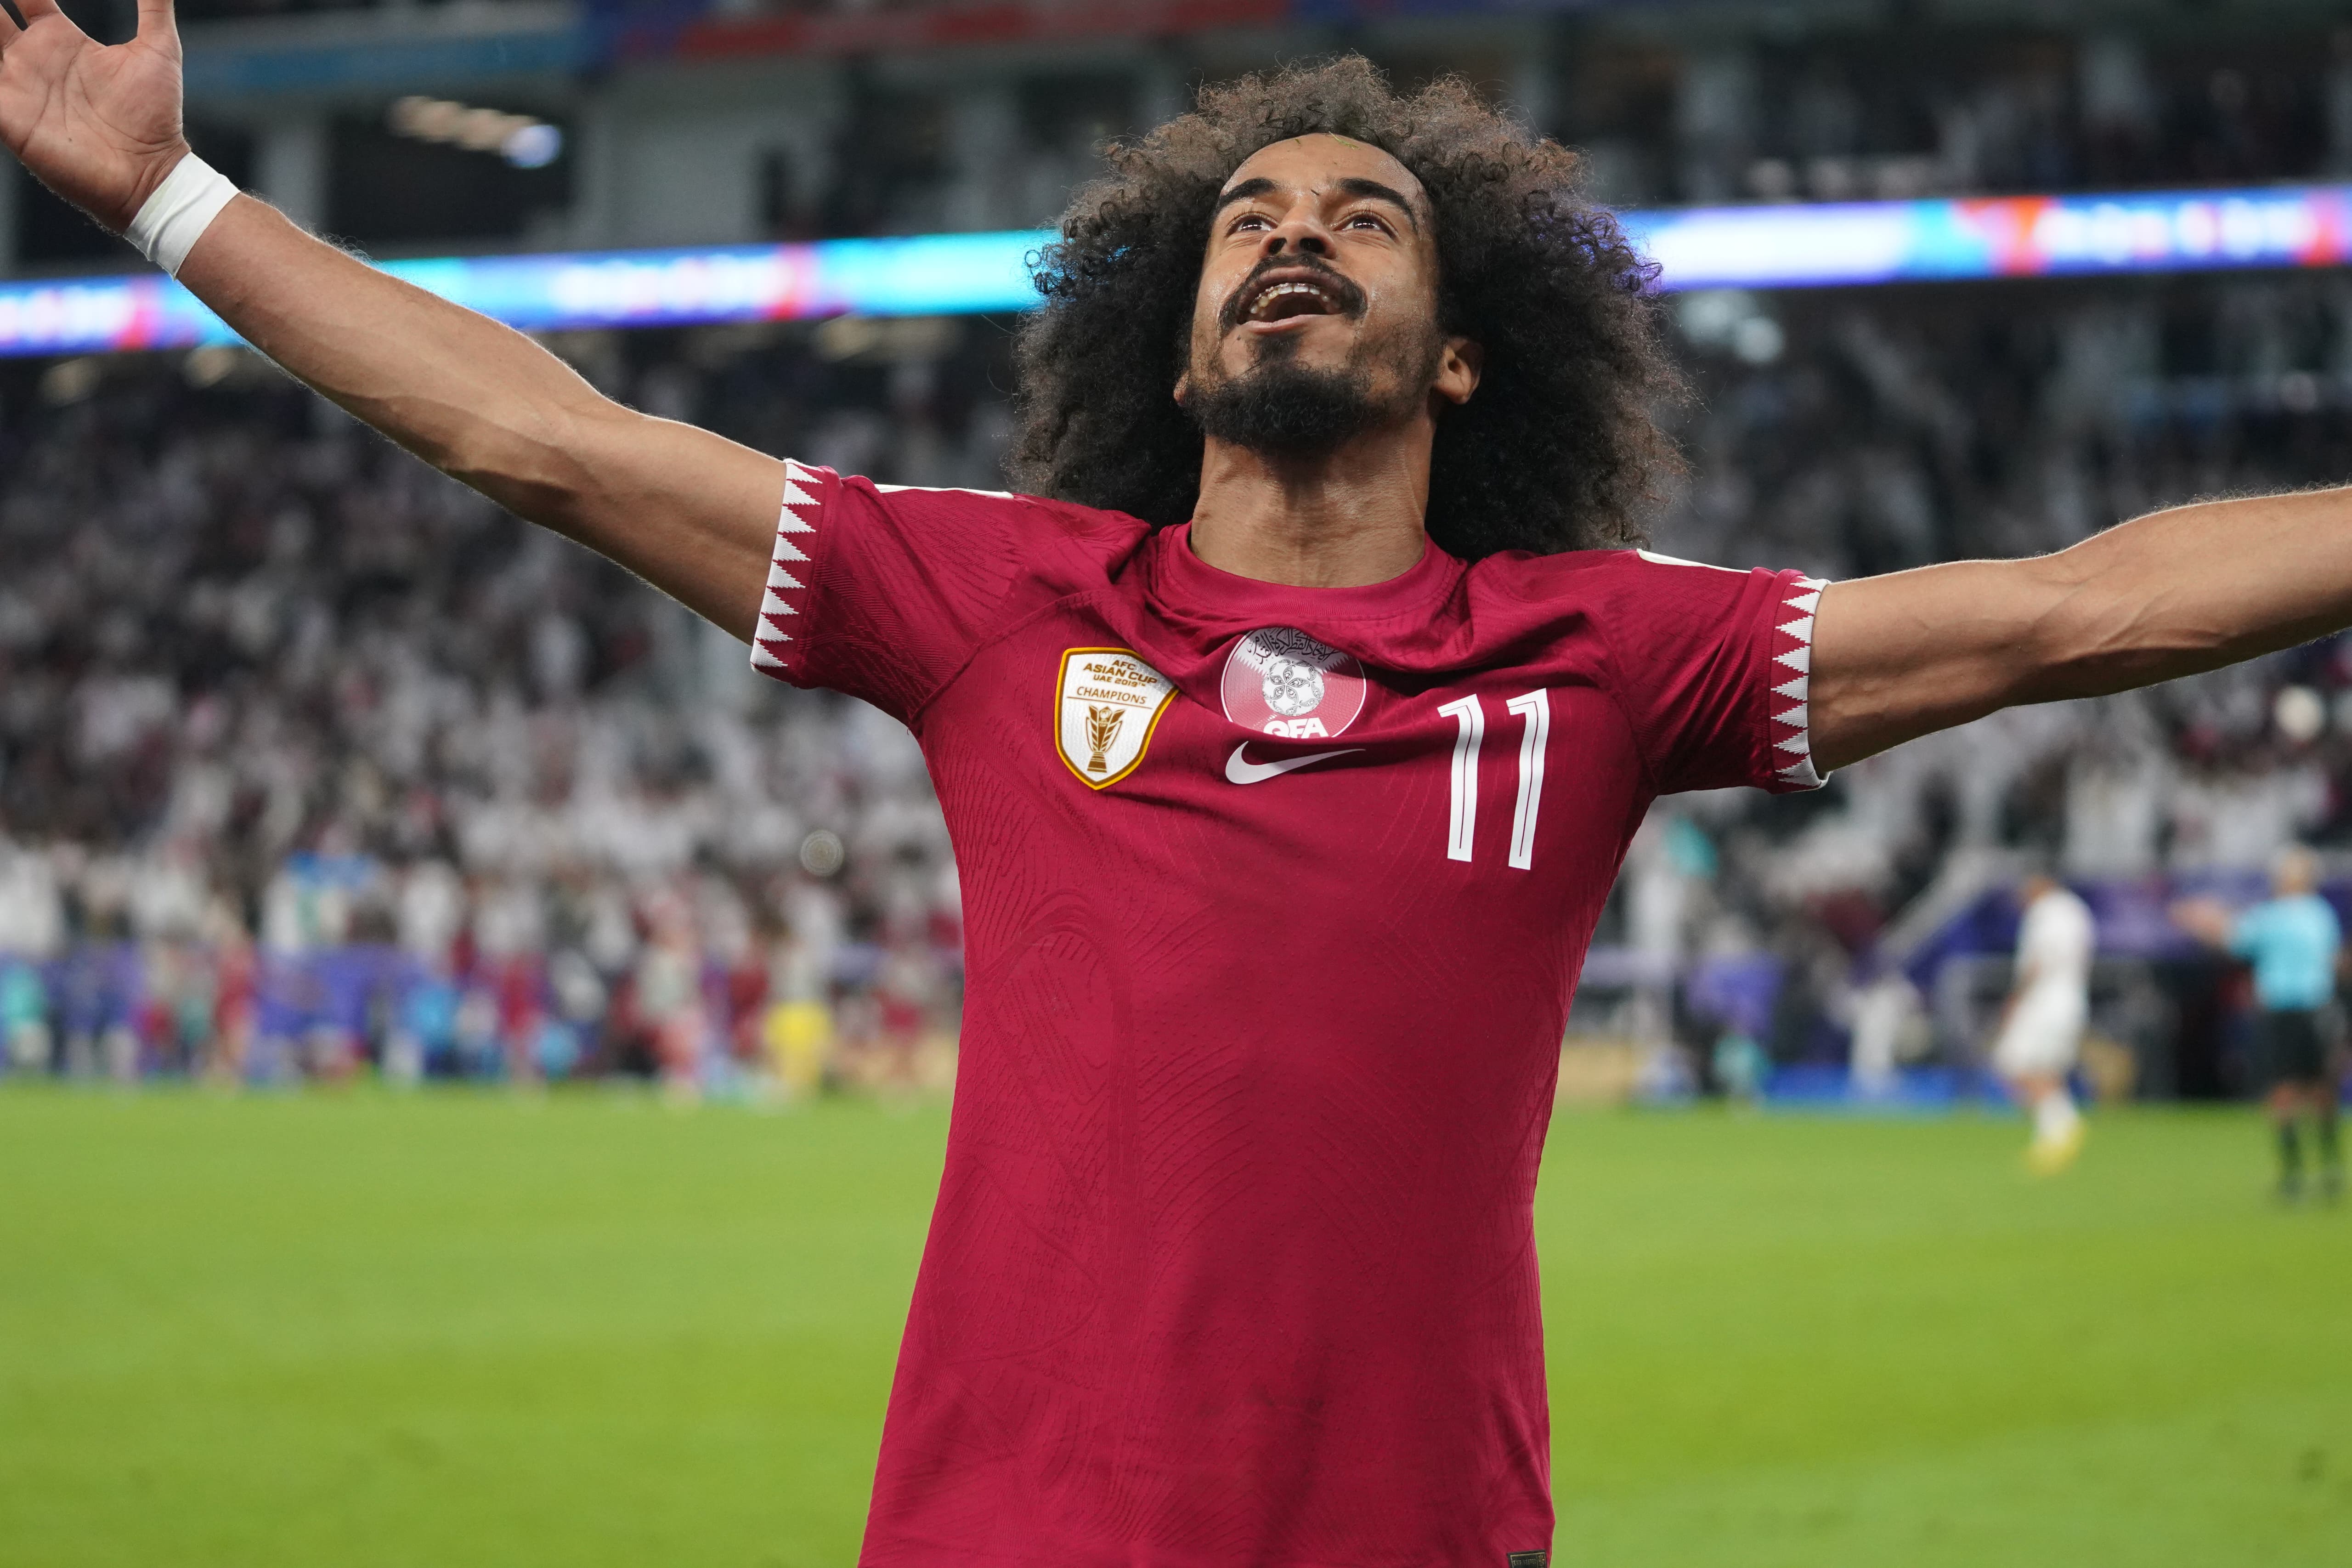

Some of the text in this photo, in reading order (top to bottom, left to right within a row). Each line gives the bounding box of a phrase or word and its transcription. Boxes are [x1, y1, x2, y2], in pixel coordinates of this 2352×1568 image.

[1083, 663, 1158, 684] ASIAN CUP
[1112, 660, 1136, 670] AFC
[1093, 674, 1113, 683] UAE
[1077, 686, 1147, 704] CHAMPIONS
[1263, 717, 1329, 739] QFA
[1437, 688, 1549, 871] 11
